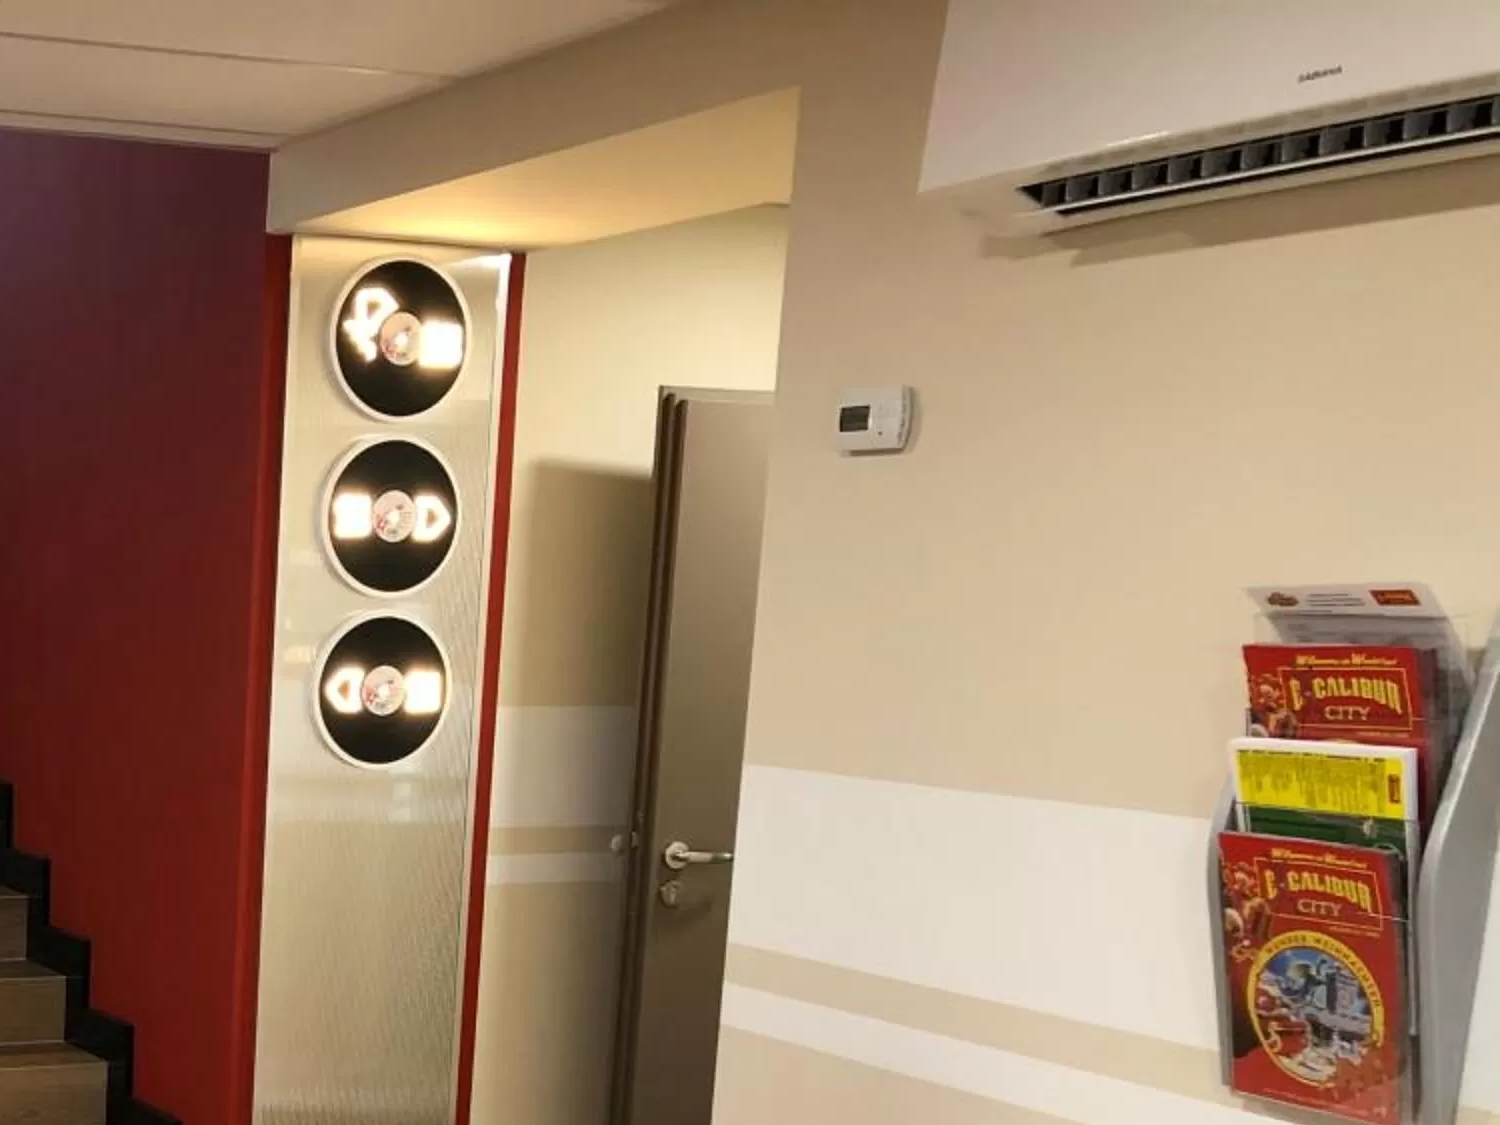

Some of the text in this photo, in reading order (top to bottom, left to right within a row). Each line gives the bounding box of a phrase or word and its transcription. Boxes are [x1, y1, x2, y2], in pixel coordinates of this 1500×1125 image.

[1289, 676, 1403, 715] ECALIBUR
[1324, 705, 1371, 721] CITY
[1264, 869, 1373, 916] ECALIBUR
[1297, 899, 1343, 917] CITY
